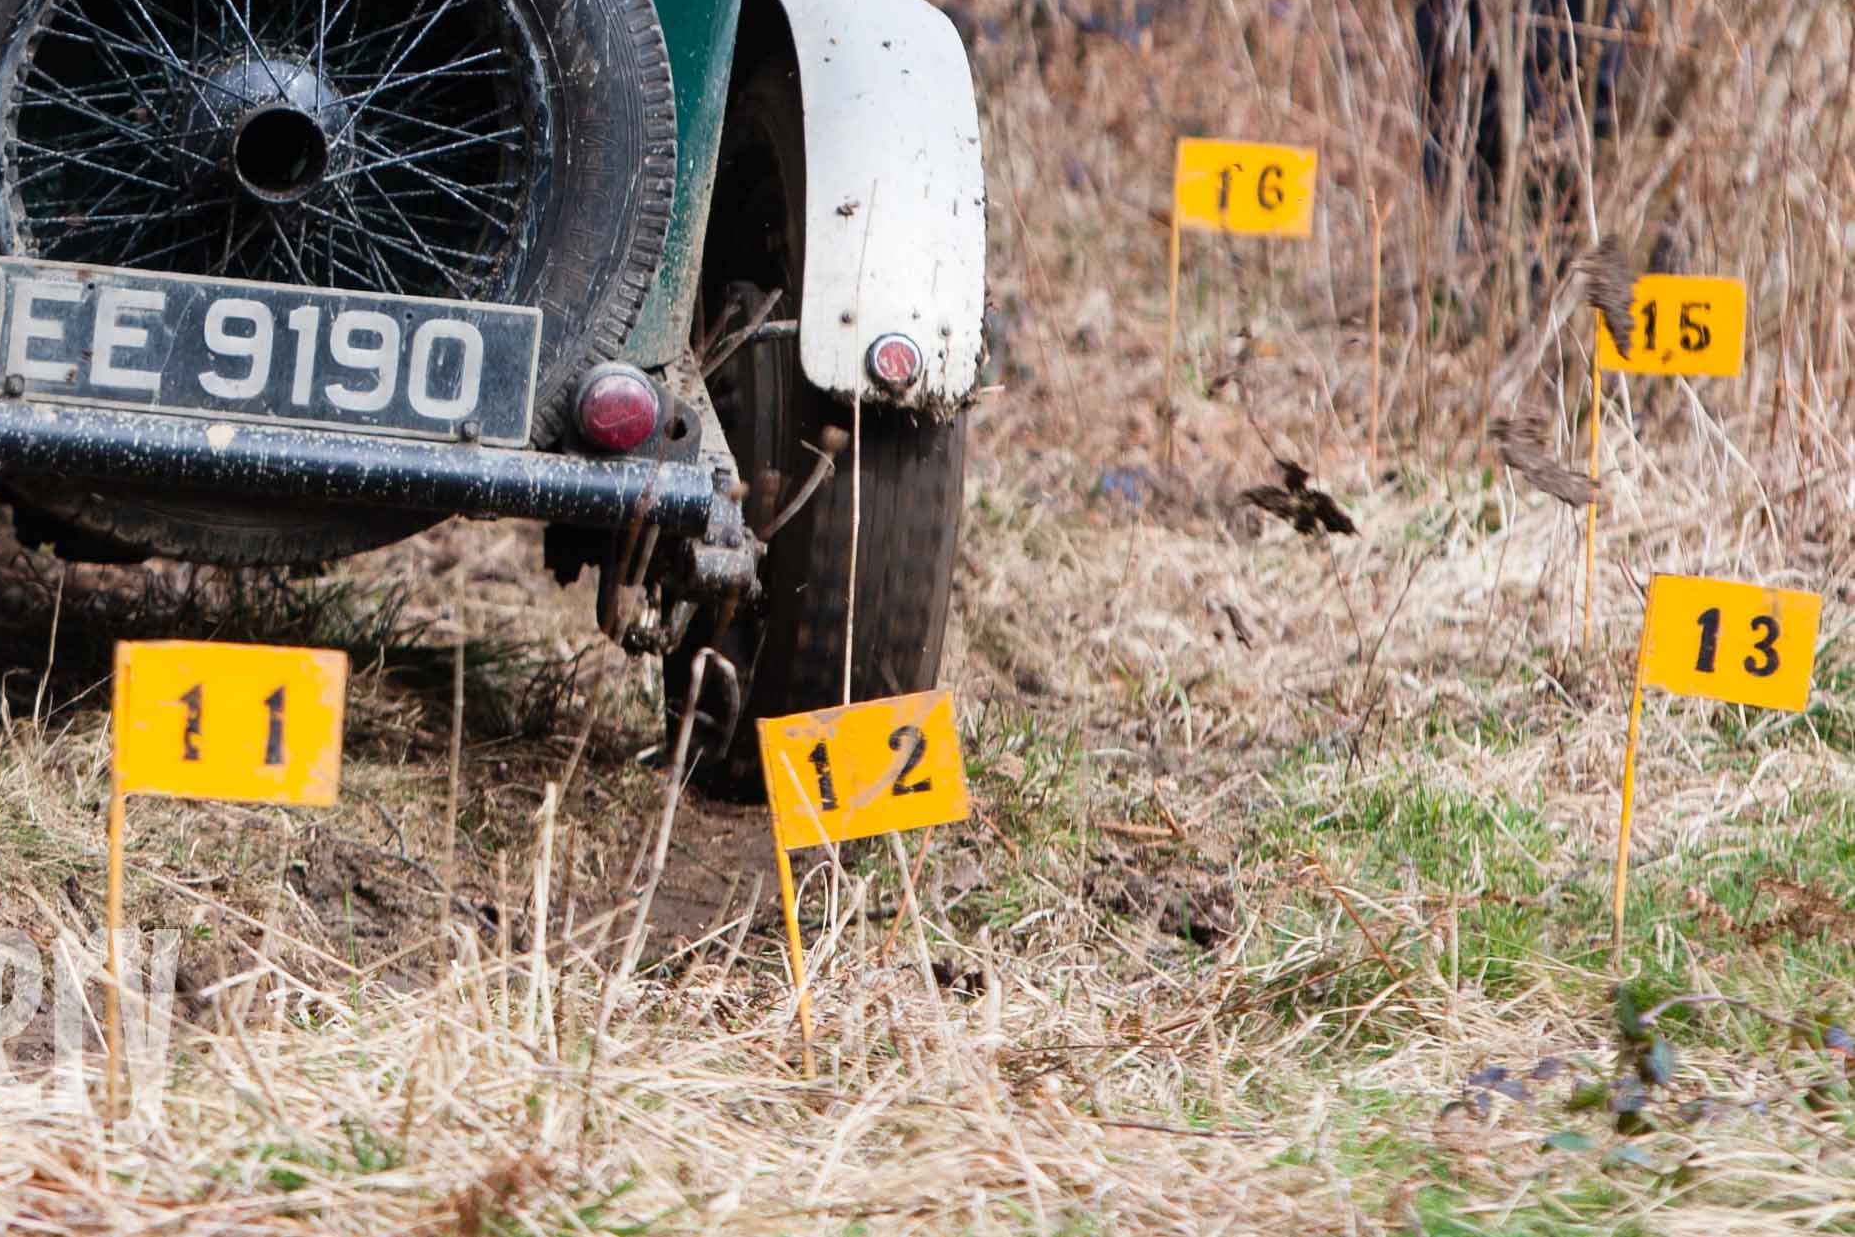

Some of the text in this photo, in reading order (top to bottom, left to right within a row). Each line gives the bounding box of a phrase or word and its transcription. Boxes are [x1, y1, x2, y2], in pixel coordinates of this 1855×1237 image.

[1217, 164, 1284, 211] 16
[5, 279, 485, 421] EE 9190
[1642, 299, 1712, 352] 15
[1695, 607, 1780, 677] 13
[180, 682, 286, 766] 11
[808, 724, 933, 812] 12
